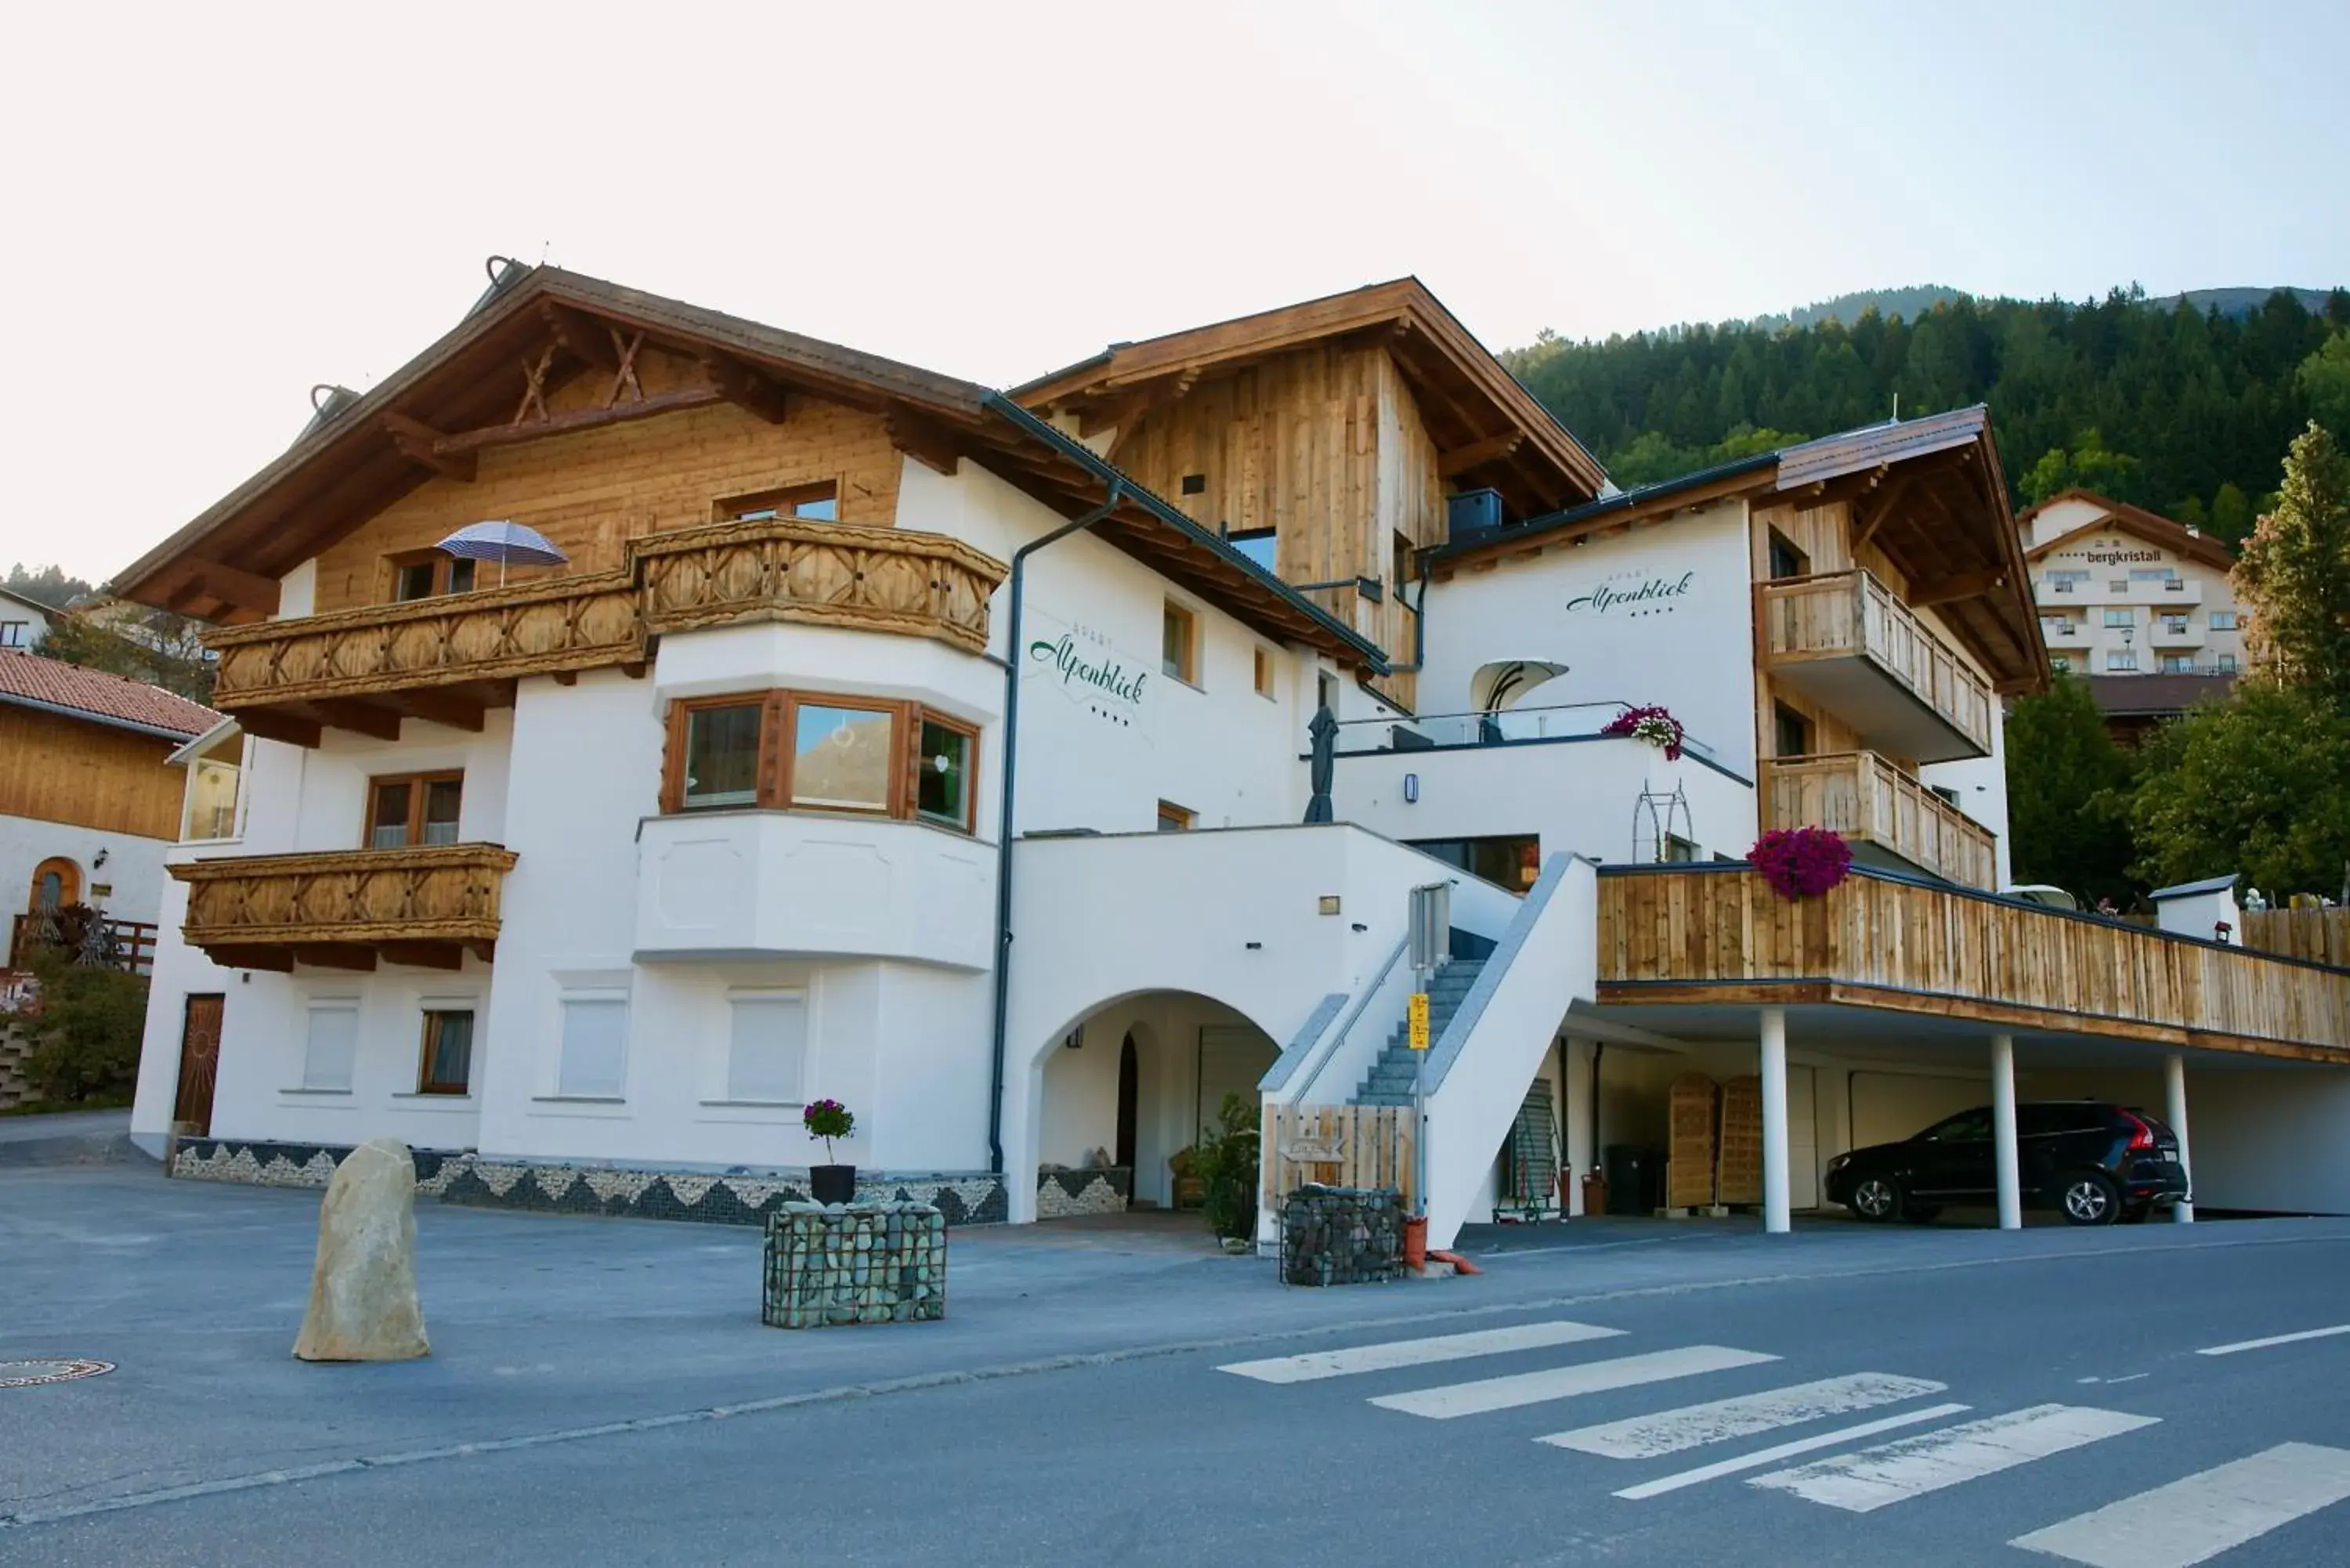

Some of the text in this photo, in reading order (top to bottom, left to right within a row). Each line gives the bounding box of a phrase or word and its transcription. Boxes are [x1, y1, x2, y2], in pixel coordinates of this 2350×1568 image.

[2088, 551, 2160, 565] bergkristall
[1567, 571, 1693, 613] Alpenblick
[1030, 634, 1147, 704] Alpenblick
